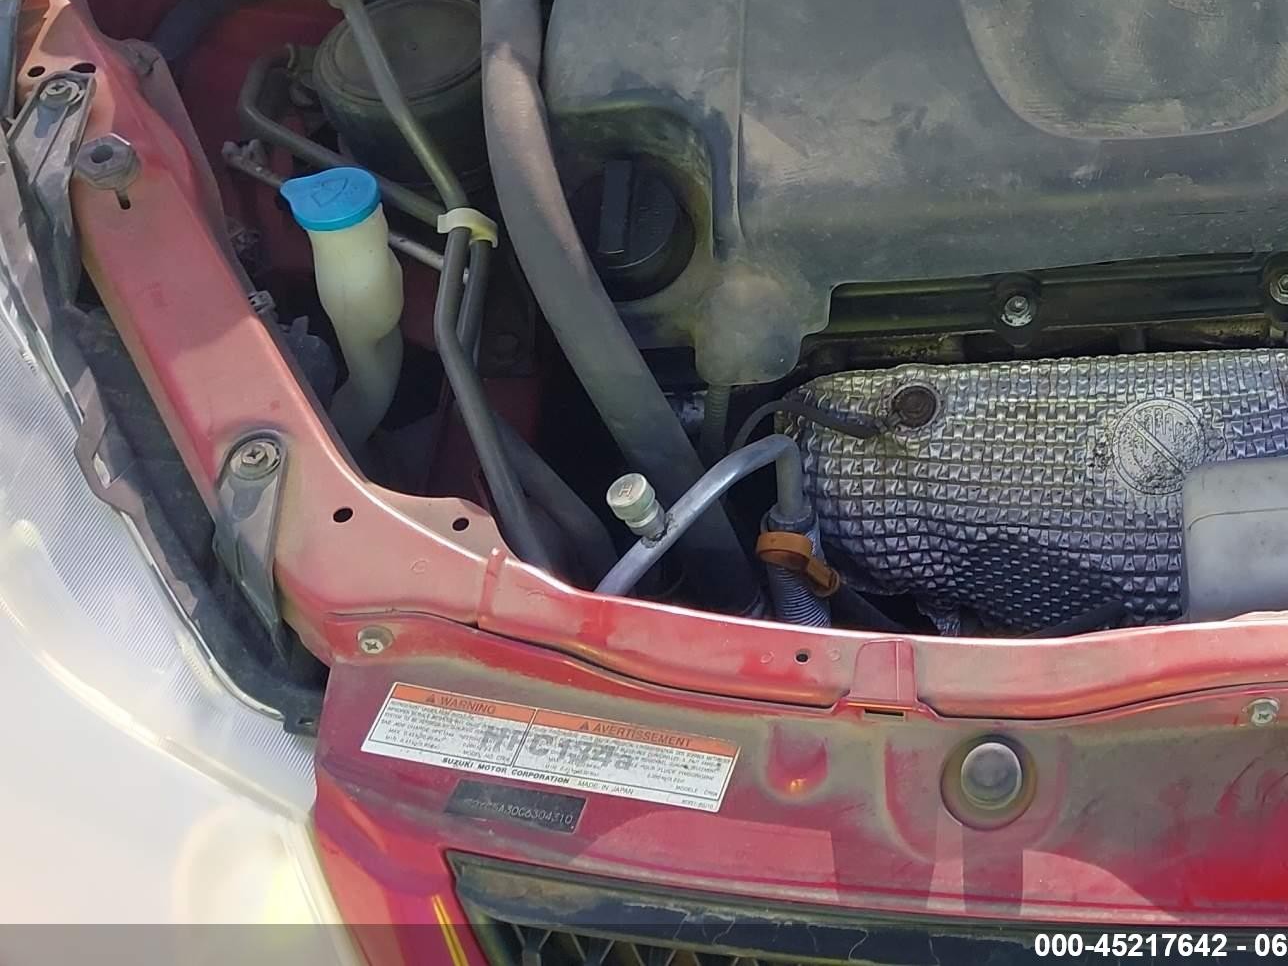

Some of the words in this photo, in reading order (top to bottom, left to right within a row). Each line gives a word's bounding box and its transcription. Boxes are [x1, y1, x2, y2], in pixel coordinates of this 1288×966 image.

[439, 696, 496, 715] WARNING
[593, 722, 693, 747] AVERTISSEMENT
[441, 757, 474, 768] SUZUKI
[477, 763, 508, 774] MOTOR
[511, 769, 570, 784] CORPORATION
[611, 785, 635, 795] JAPAN
